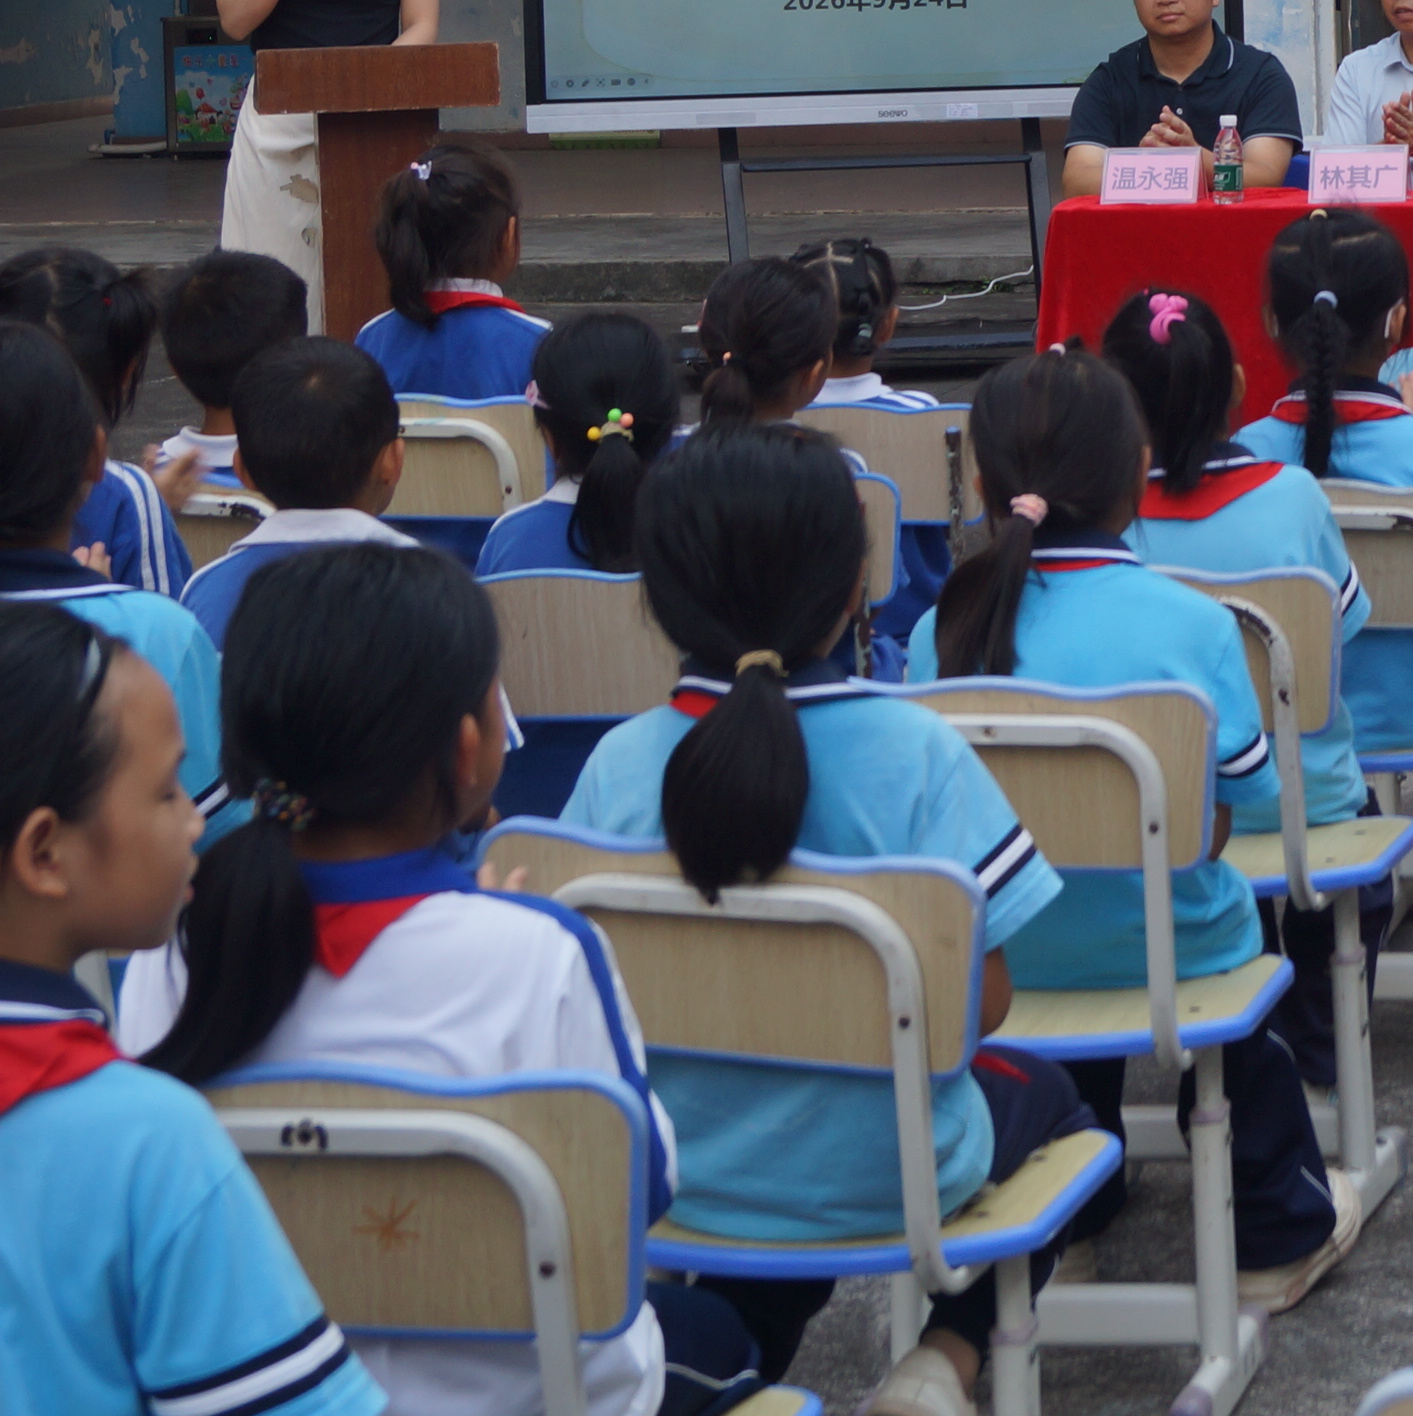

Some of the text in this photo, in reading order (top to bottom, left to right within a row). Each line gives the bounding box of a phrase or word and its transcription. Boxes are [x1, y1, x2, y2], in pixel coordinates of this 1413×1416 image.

[1111, 165, 1189, 192] 温永强
[1320, 164, 1399, 190] 林其广
